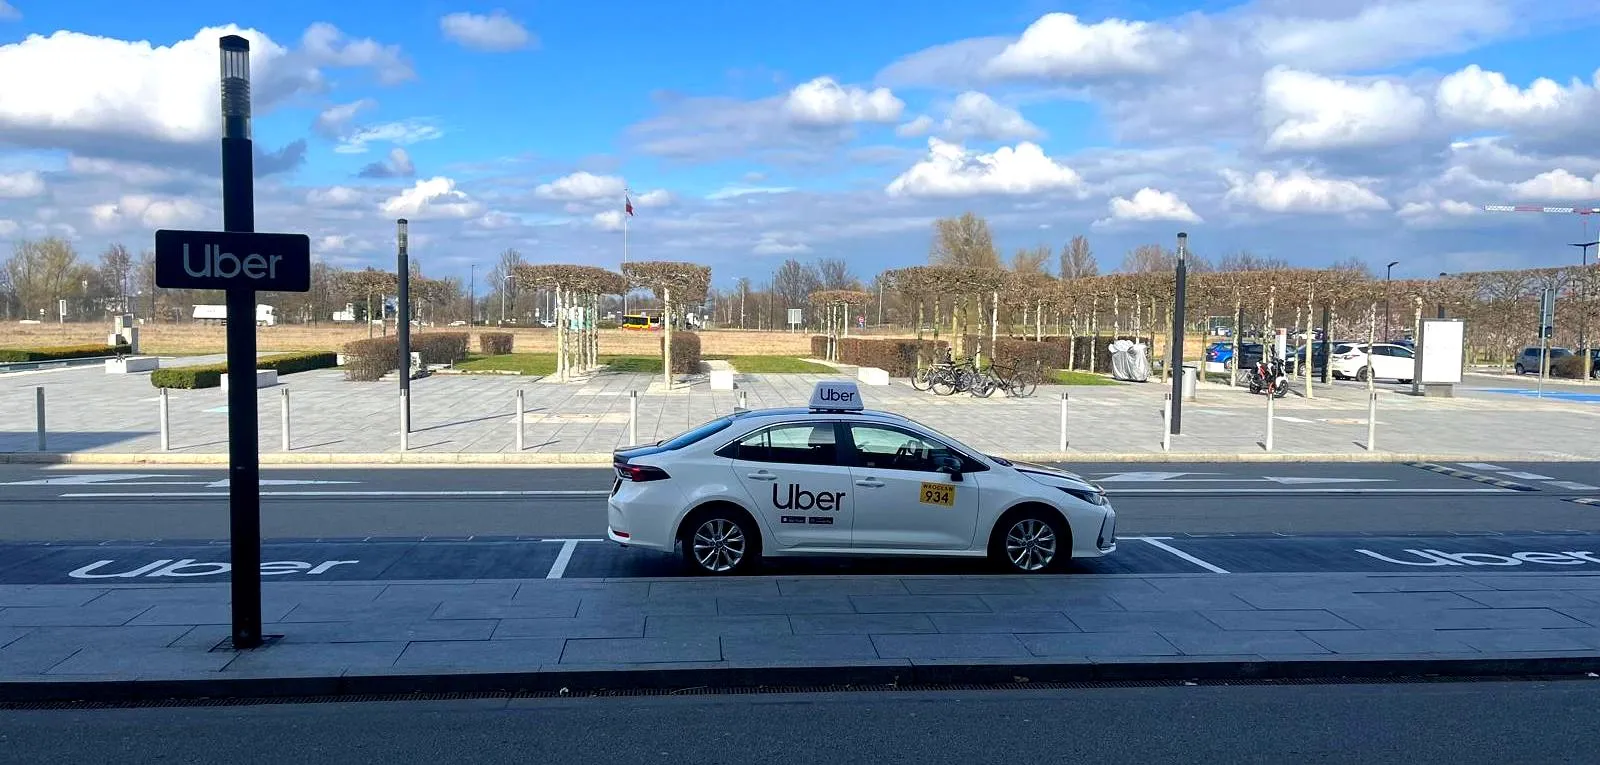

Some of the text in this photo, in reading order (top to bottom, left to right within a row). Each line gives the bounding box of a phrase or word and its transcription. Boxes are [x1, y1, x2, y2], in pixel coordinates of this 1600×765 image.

[183, 243, 283, 279] Uber
[820, 387, 855, 402] Uber
[772, 482, 846, 512] Uber
[925, 490, 949, 503] 934
